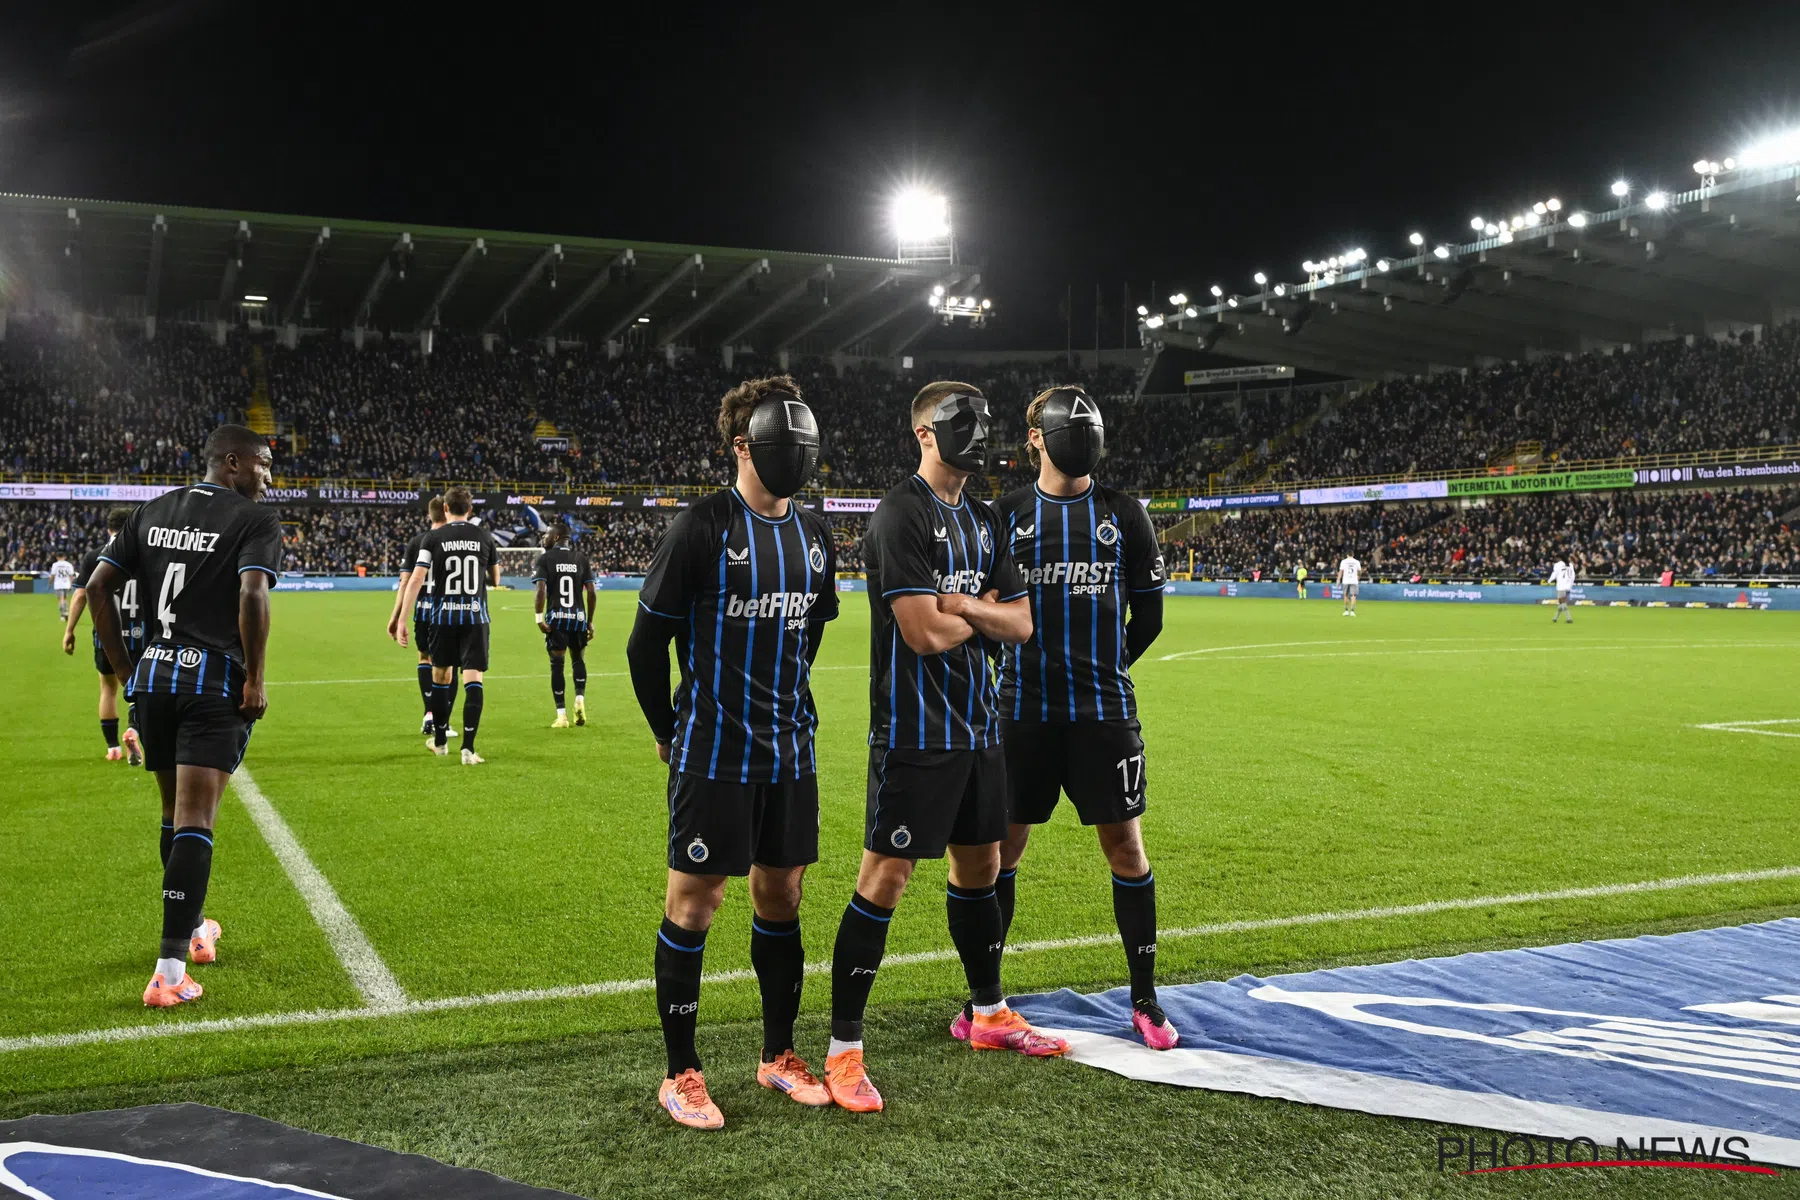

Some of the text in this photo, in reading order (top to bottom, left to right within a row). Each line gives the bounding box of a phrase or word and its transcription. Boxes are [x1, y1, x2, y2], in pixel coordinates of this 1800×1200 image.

[1697, 468, 1714, 479] Van
[1716, 466, 1733, 478] den
[1450, 480, 1508, 493] INTERMETAL
[1512, 477, 1547, 490] MOTOR
[1549, 476, 1564, 488] NV
[266, 488, 308, 498] WOODS
[319, 489, 420, 500] RIVER WOODS
[1188, 497, 1223, 510] Dekeyser
[148, 526, 220, 552] ORDÓÑEZ
[441, 540, 481, 552] VANAKEN
[556, 563, 578, 573] FORBS
[445, 555, 479, 595] 20
[560, 575, 574, 608] 9
[1403, 588, 1417, 598] Port
[158, 562, 186, 639] 4
[441, 601, 471, 611] Allianz
[1116, 754, 1142, 792] 17
[162, 889, 185, 900] FCB
[1138, 943, 1157, 955] FCB
[669, 1001, 698, 1015] FCB
